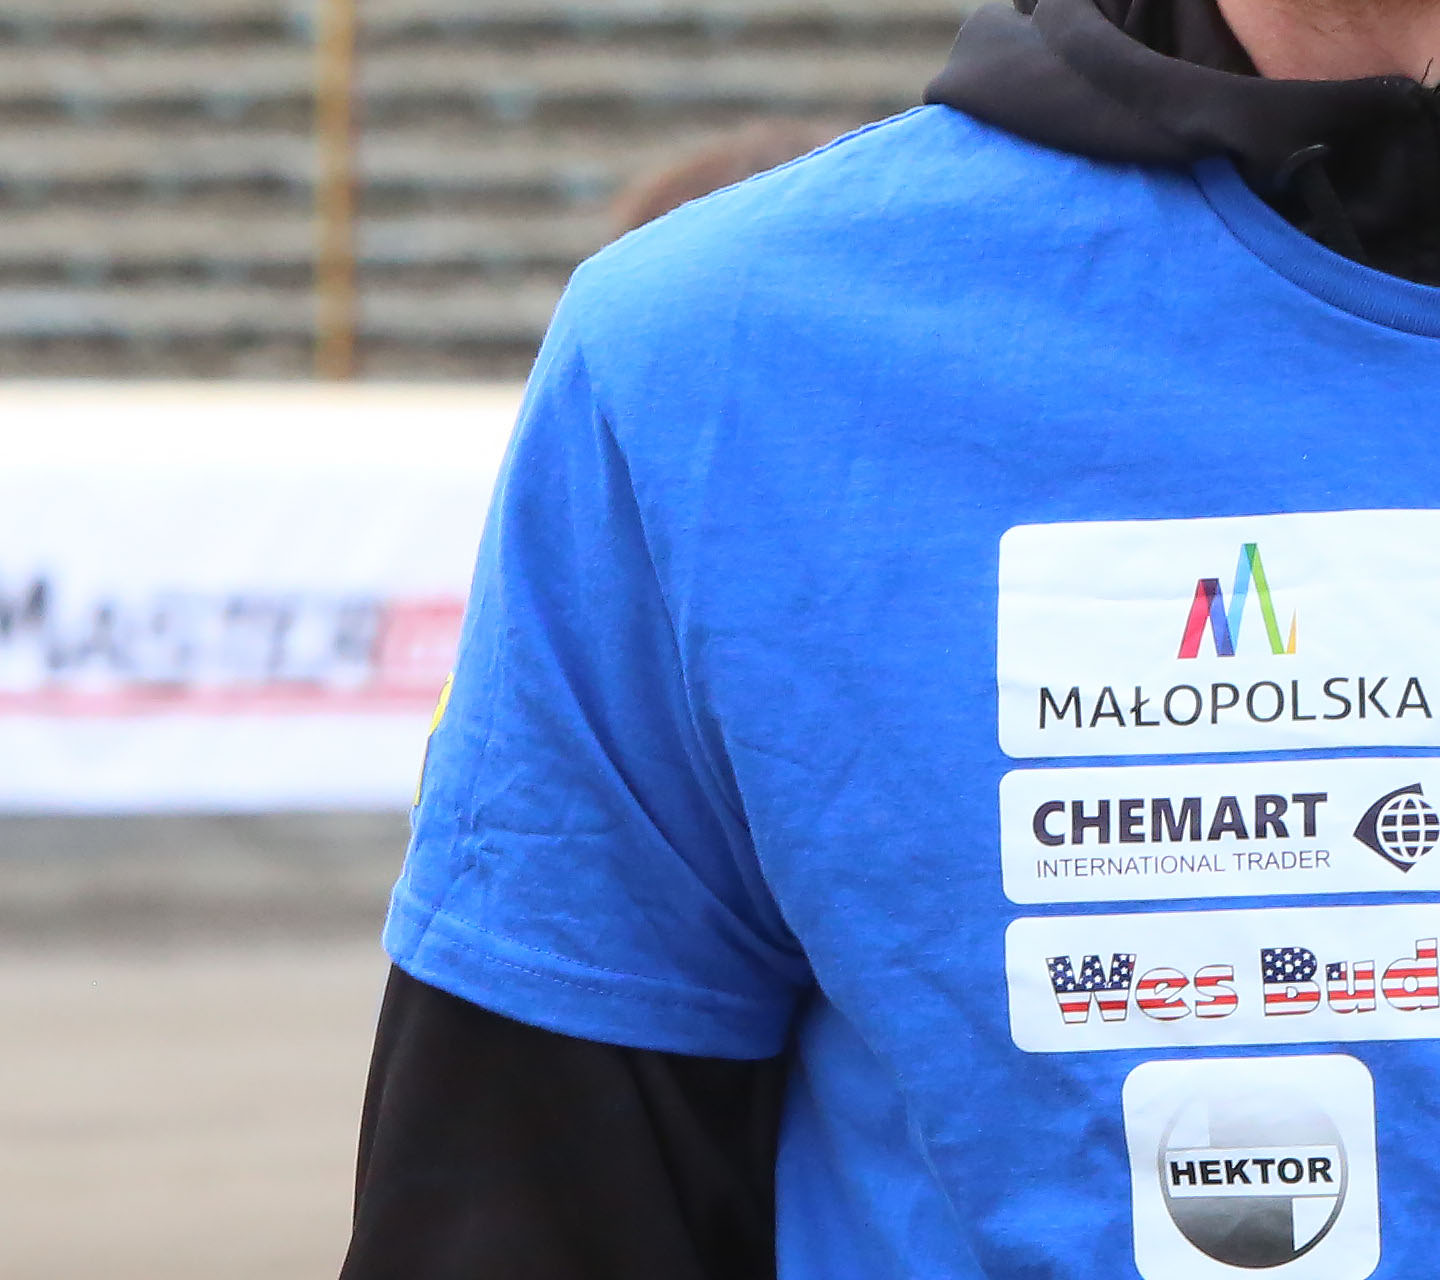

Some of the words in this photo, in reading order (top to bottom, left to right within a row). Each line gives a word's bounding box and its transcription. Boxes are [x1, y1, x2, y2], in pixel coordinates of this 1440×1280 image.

[1038, 676, 1433, 729] MAŁOPOLSKA
[1032, 791, 1329, 846] CHEMART
[1036, 853, 1226, 879] INTERNATIONAL
[1233, 849, 1331, 871] TRADER
[1045, 952, 1240, 1024] Wes
[1260, 937, 1440, 1016] Bud
[1169, 1157, 1335, 1187] HEKTOR
